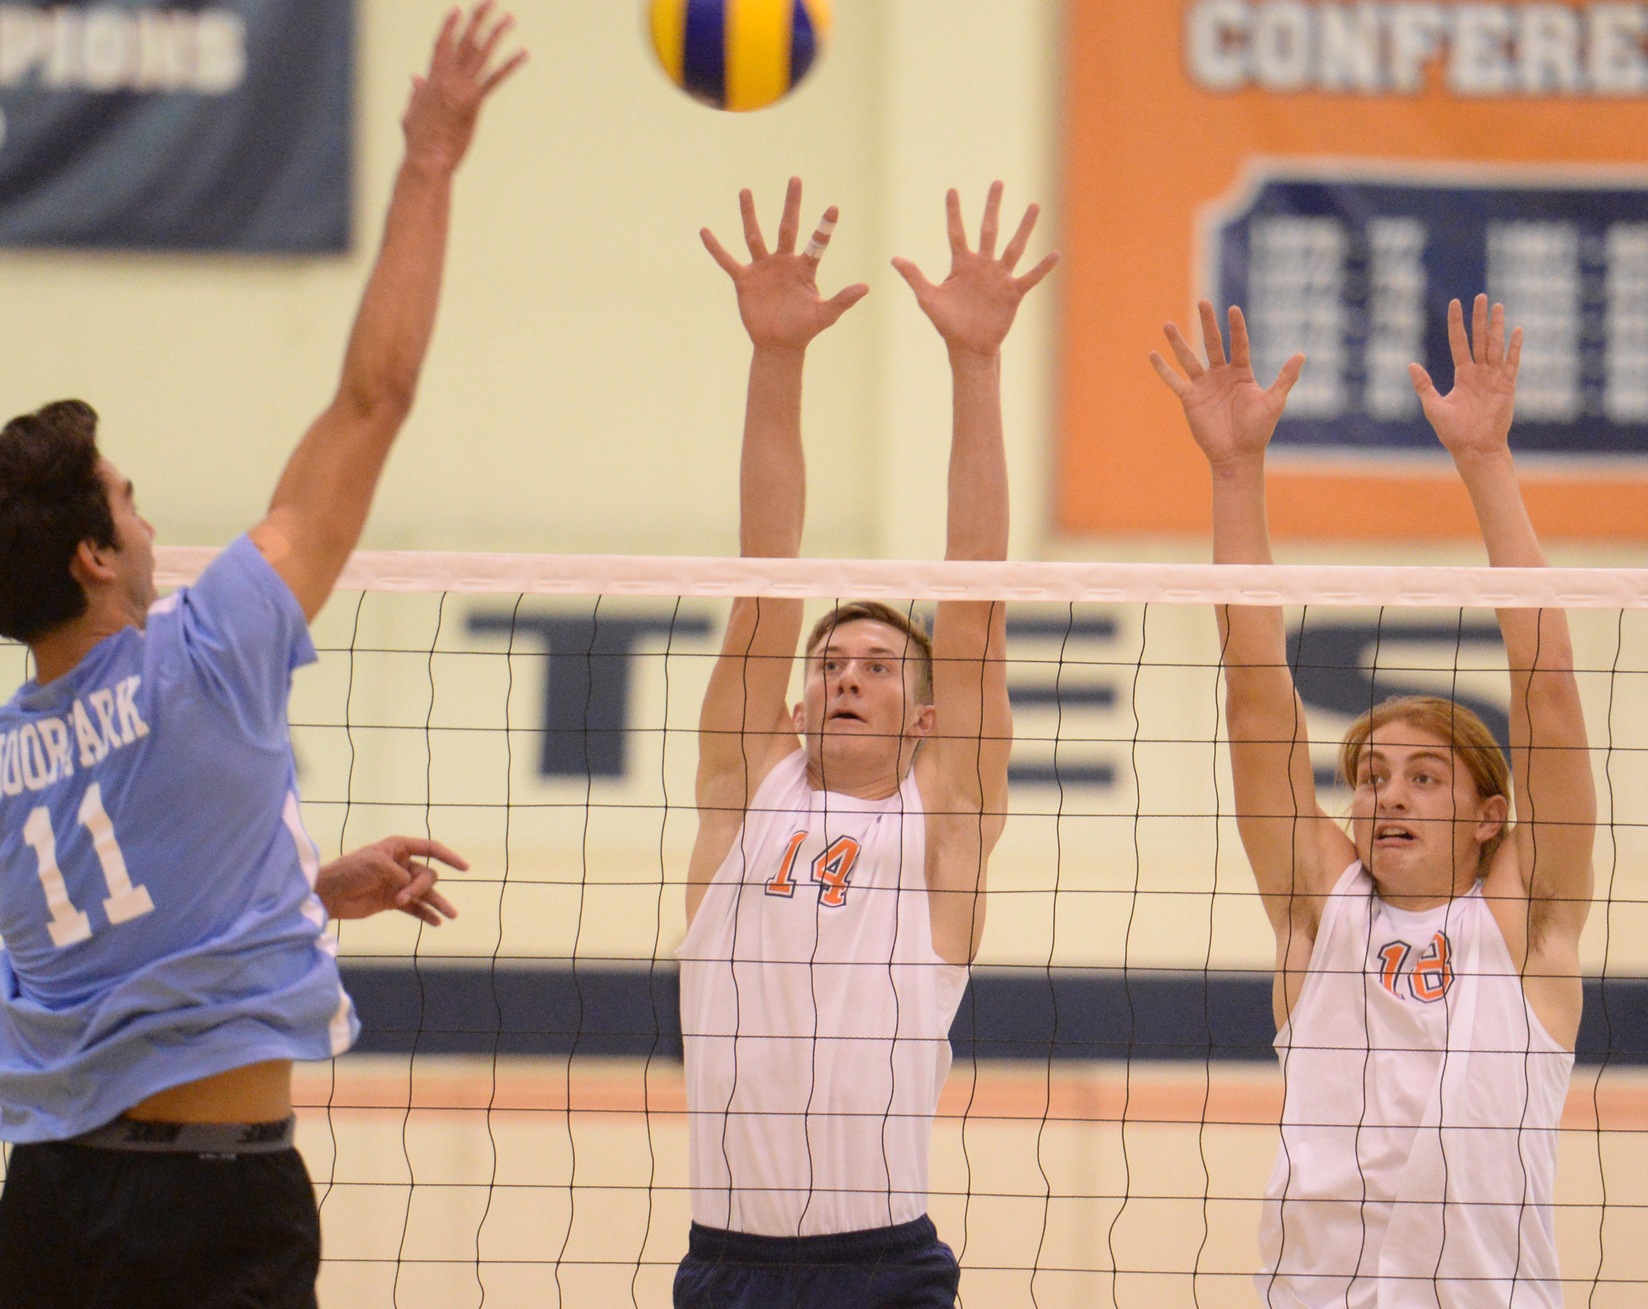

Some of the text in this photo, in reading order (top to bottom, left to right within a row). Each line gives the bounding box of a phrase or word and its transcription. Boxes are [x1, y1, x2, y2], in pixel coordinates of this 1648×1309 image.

[0, 675, 150, 798] OORARK
[22, 781, 155, 949] 11
[764, 829, 862, 908] 14
